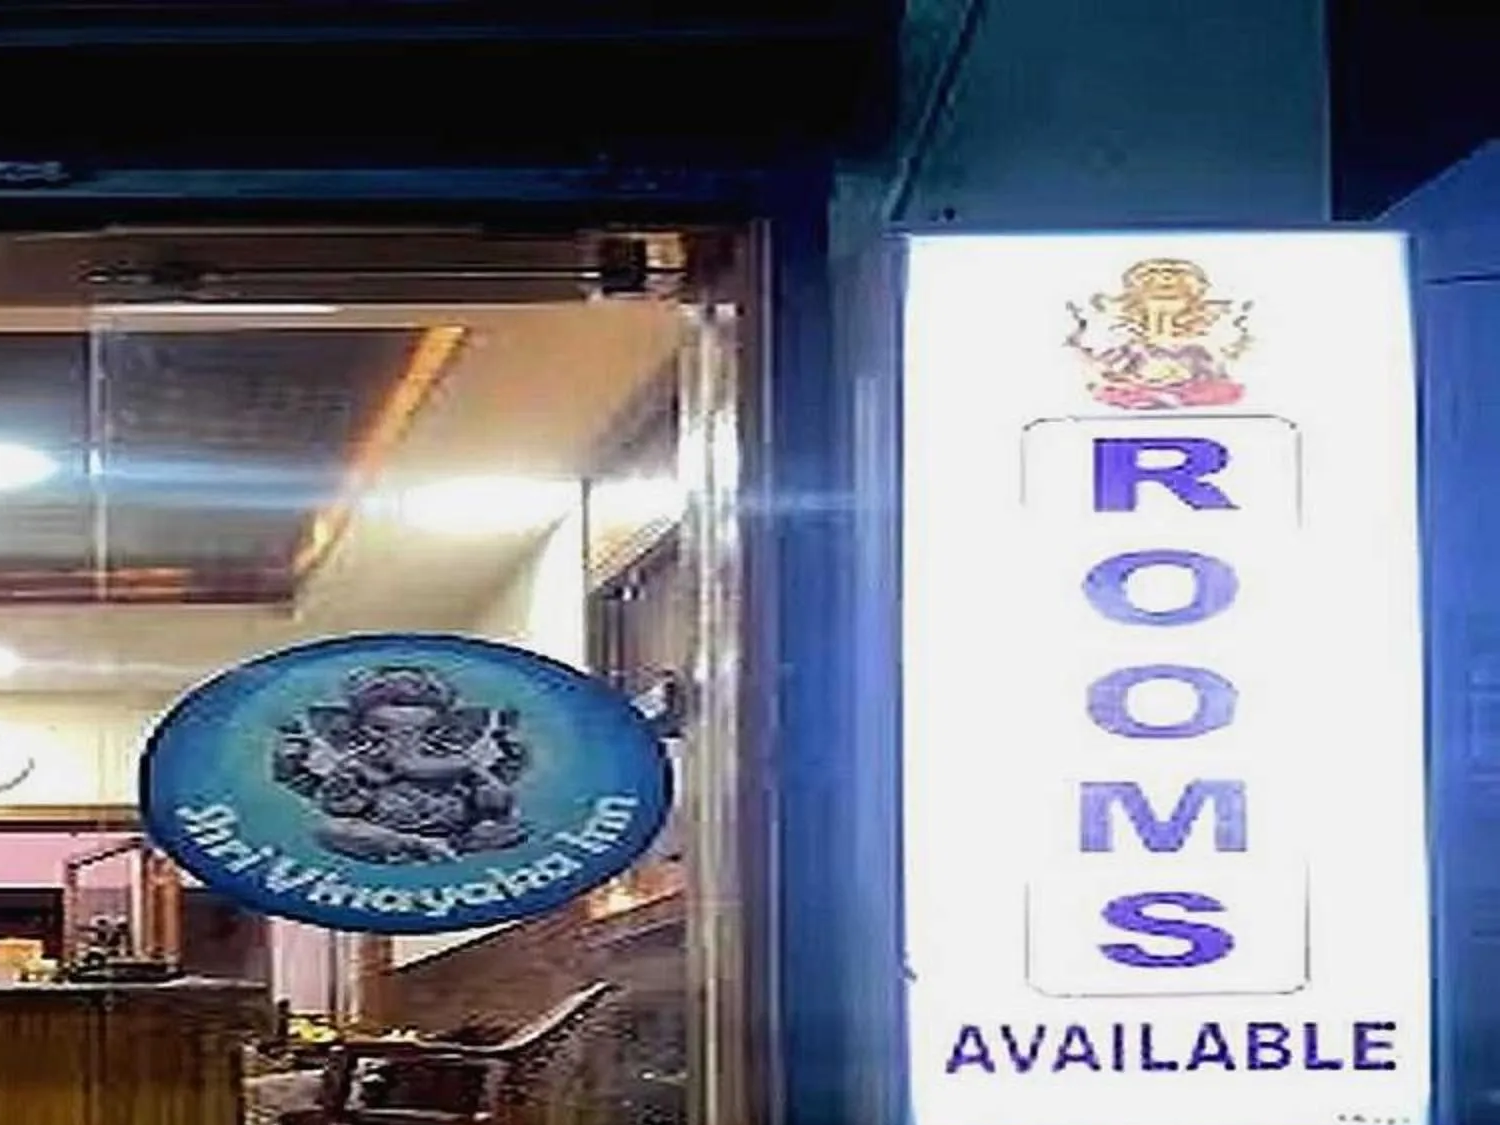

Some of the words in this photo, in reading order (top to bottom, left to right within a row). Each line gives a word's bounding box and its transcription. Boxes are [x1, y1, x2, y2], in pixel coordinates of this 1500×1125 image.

[1079, 436, 1248, 970] ROOMS
[175, 803, 273, 873] Shri
[265, 853, 583, 917] Vinayaka
[945, 1020, 1398, 1075] AVAILABLE
